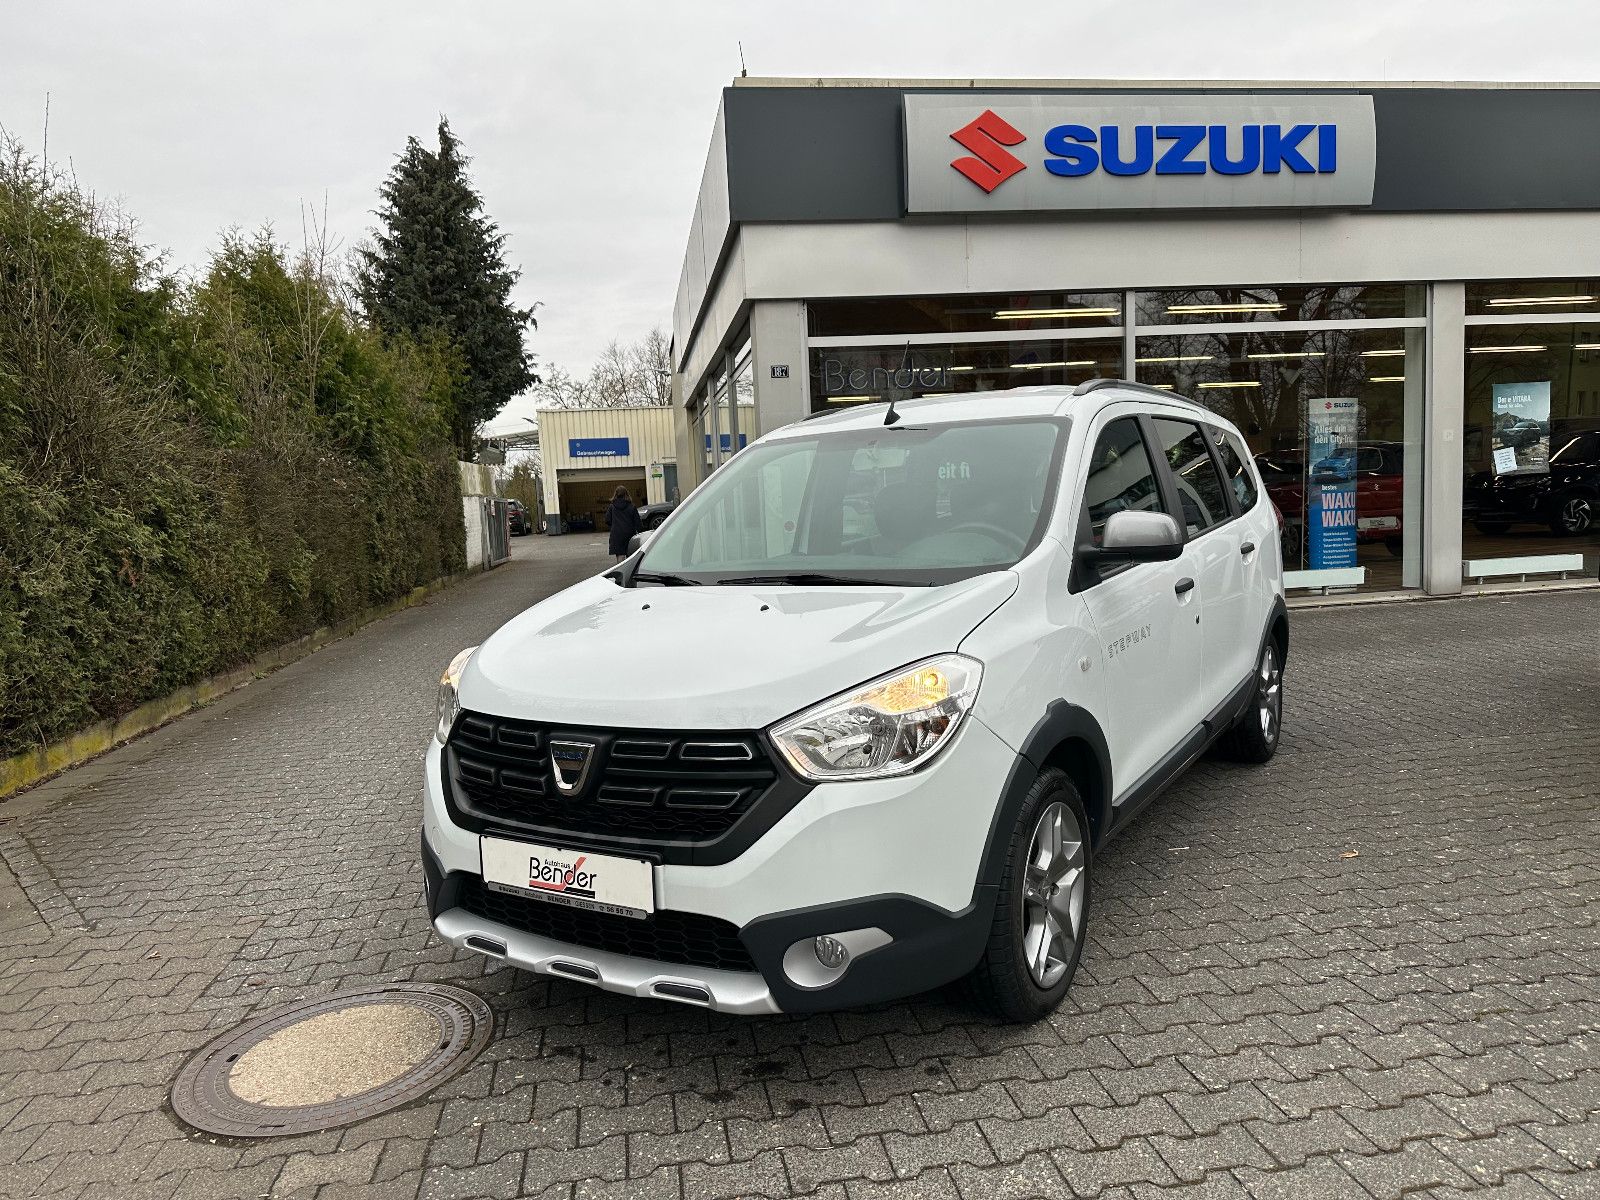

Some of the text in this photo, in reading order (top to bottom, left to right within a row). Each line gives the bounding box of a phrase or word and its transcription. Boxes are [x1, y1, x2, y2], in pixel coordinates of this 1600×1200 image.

[1044, 124, 1337, 177] SUZUKI
[825, 357, 948, 392] Bender
[1315, 425, 1333, 433] Alles
[1314, 434, 1328, 443] den
[1321, 492, 1356, 510] WAKU
[1321, 510, 1356, 528] WAKU
[1107, 623, 1151, 659] STEPWAY
[529, 857, 597, 889] Bender
[544, 859, 571, 869] Autohaus
